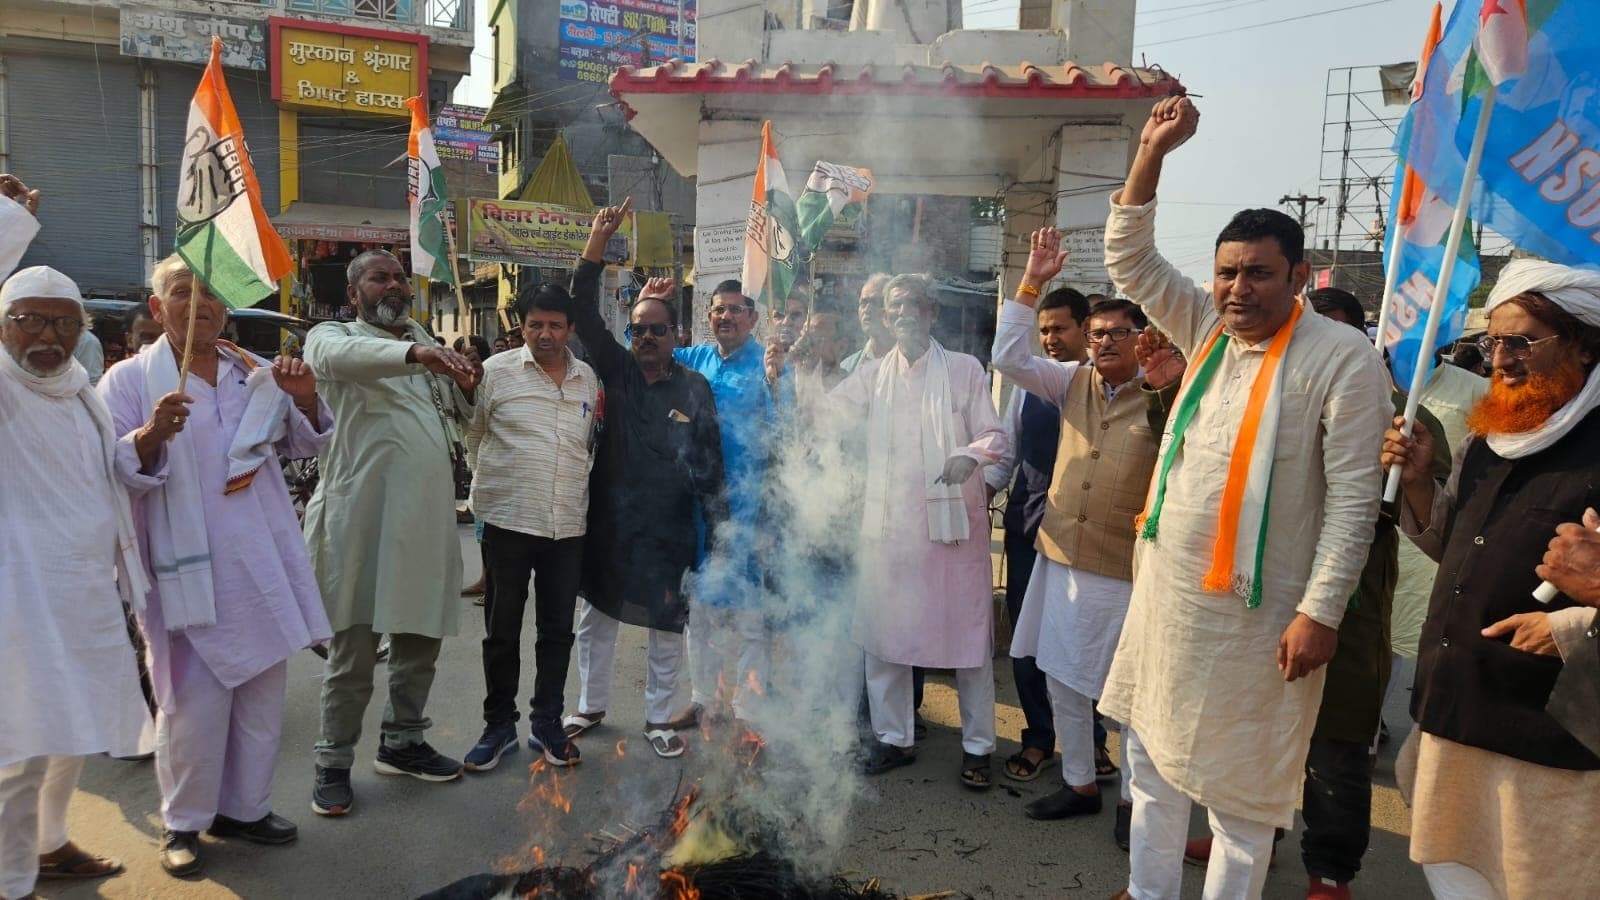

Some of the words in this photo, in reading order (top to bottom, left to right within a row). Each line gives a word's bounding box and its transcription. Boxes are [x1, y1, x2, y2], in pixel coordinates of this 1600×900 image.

[289, 41, 356, 65] मुस्कान
[345, 70, 360, 84] &
[354, 90, 404, 109] हाउस
[481, 203, 533, 226] बिहार
